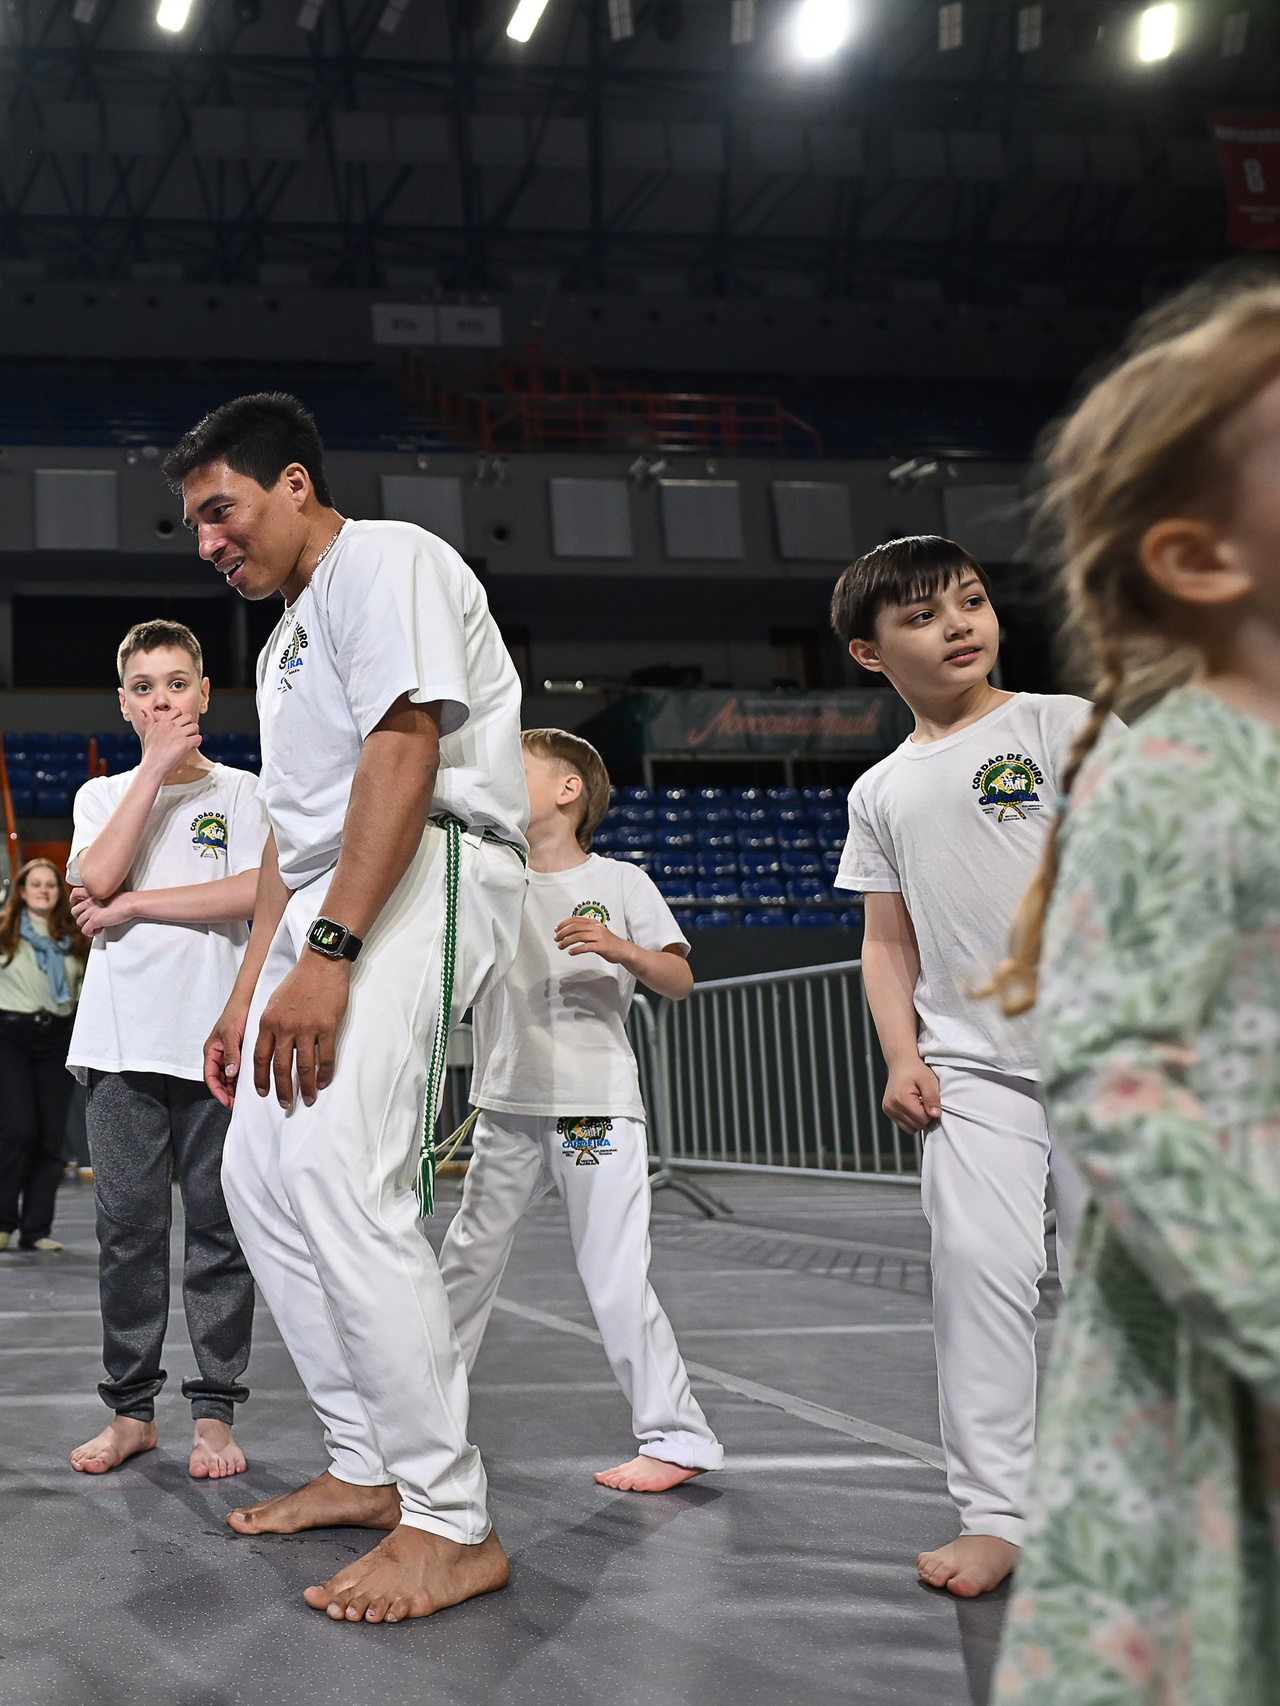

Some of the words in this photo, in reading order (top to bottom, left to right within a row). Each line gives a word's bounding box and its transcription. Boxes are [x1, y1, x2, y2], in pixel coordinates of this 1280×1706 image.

[972, 754, 1004, 790] CORDÃO
[1006, 753, 1022, 762] DE
[1023, 758, 1044, 785] OURO
[215, 812, 225, 820] DE
[562, 1139, 611, 1149] CAPOEIRA
